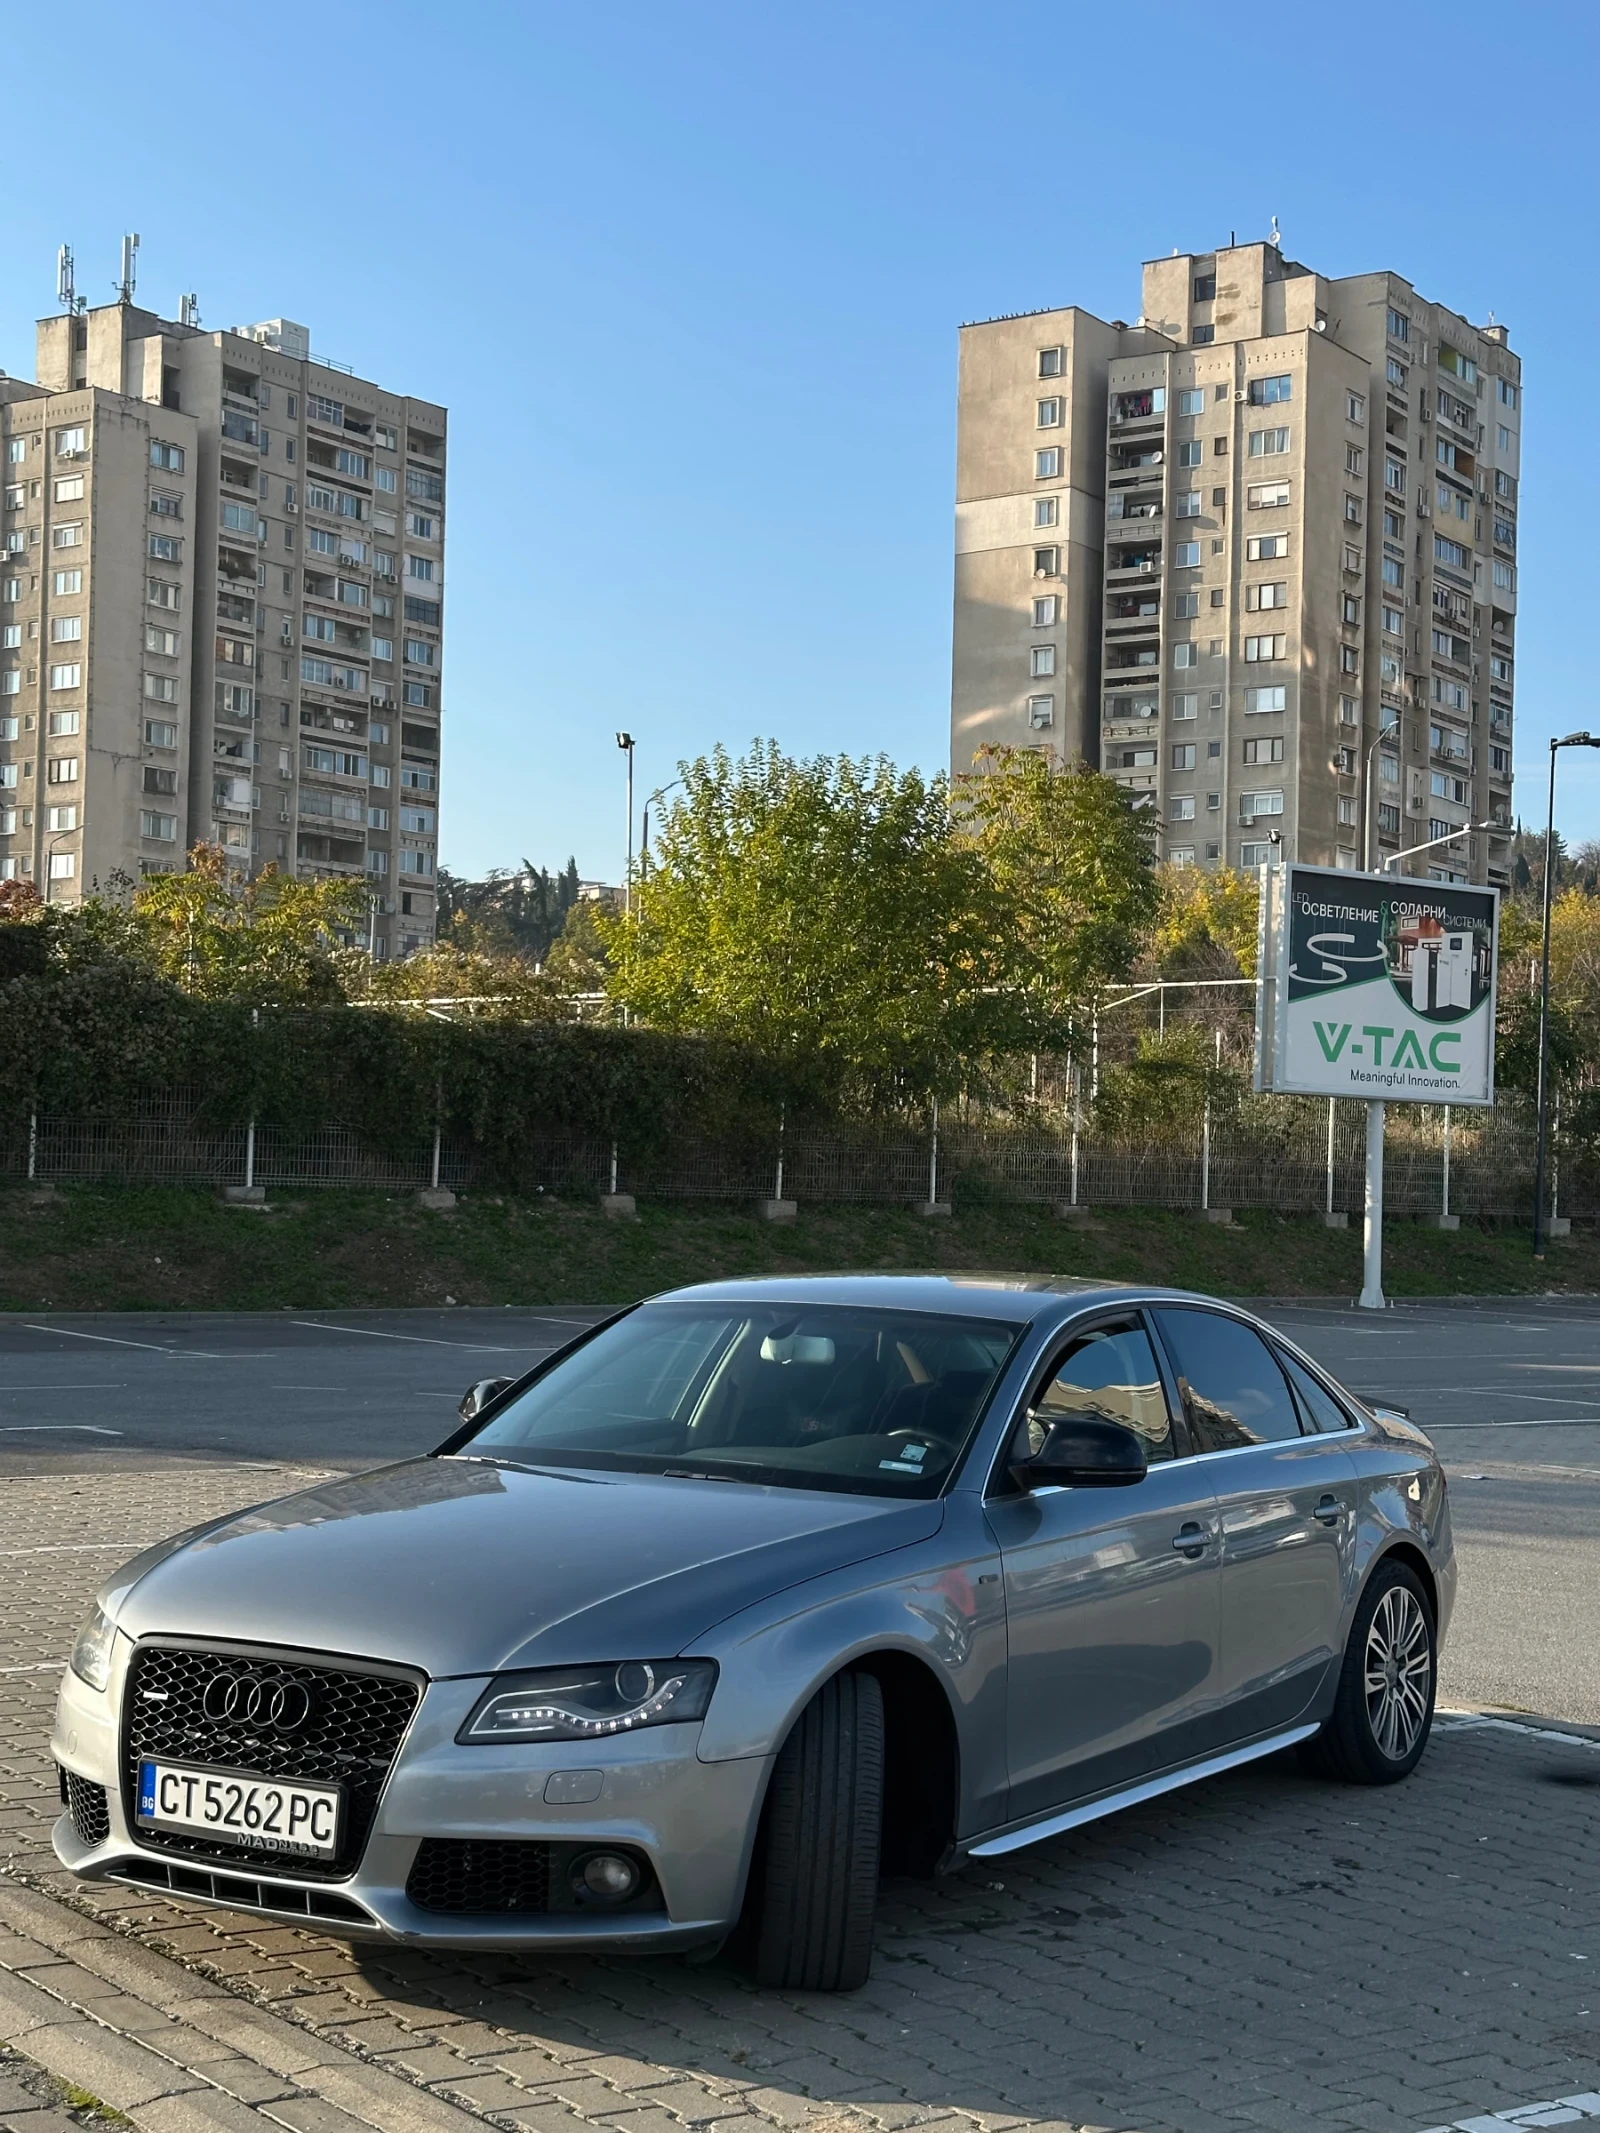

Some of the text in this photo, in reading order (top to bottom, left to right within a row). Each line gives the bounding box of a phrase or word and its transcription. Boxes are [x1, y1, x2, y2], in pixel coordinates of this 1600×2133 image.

[1292, 891, 1309, 903] LED
[1302, 902, 1379, 923] ОСВЕТЛЕНИЕ
[1390, 901, 1446, 919] СОЛАРНИ
[1443, 914, 1486, 928] СИСТЕМИ
[1312, 1021, 1461, 1073] V-TAC
[1350, 1069, 1461, 1088] Meaningful Innovation.
[141, 1796, 154, 1810] BG
[237, 1833, 319, 1852] MADNESS
